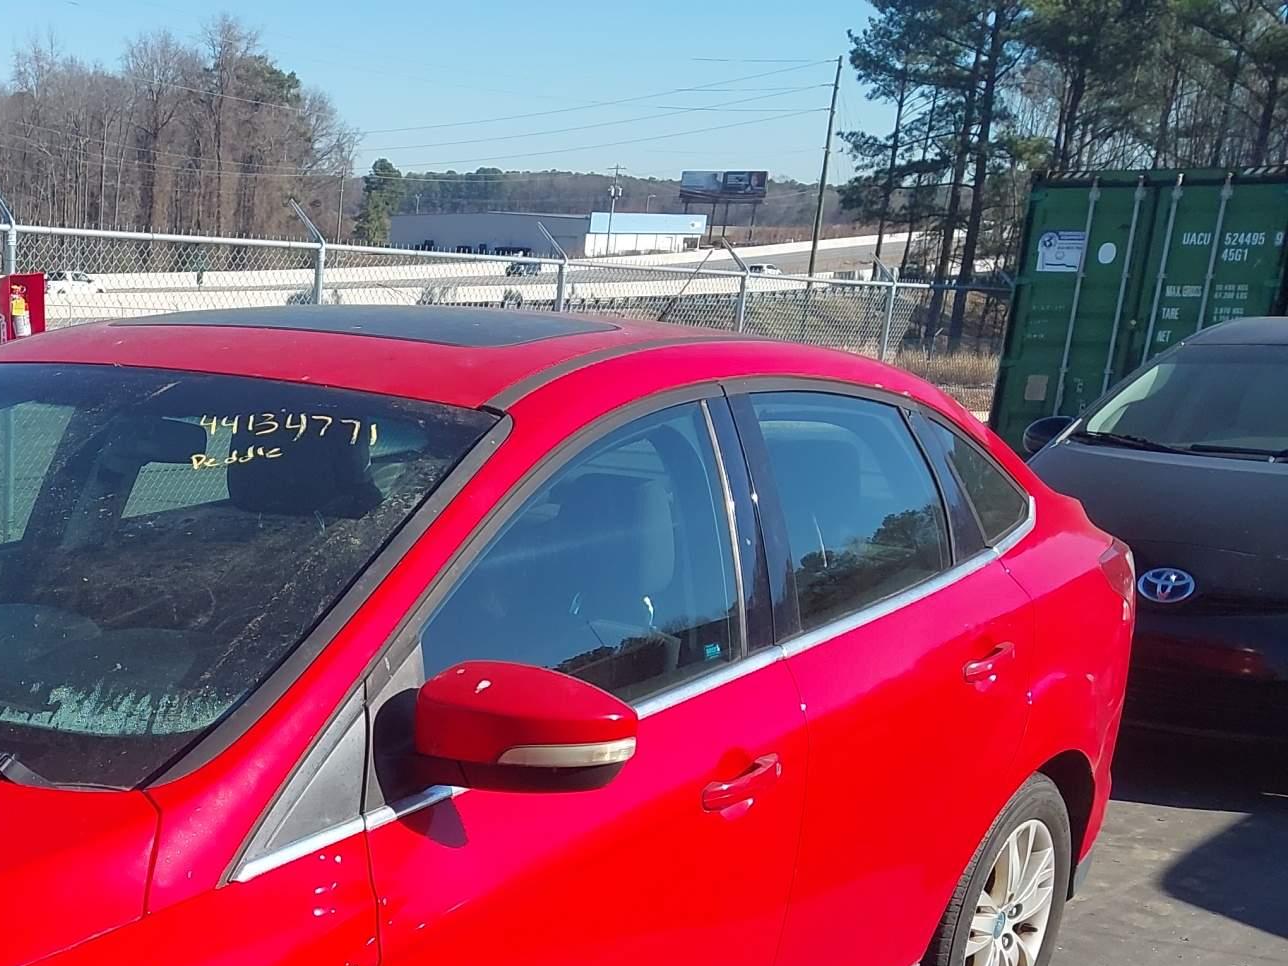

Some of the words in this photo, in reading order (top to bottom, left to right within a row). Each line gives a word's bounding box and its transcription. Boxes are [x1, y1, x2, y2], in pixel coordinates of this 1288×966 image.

[1182, 232, 1212, 245] UACU
[1224, 232, 1266, 245] 524495
[1274, 231, 1284, 246] 9
[1221, 248, 1249, 262] 45G1
[1161, 307, 1180, 320] TARE
[199, 413, 378, 446] 44134771
